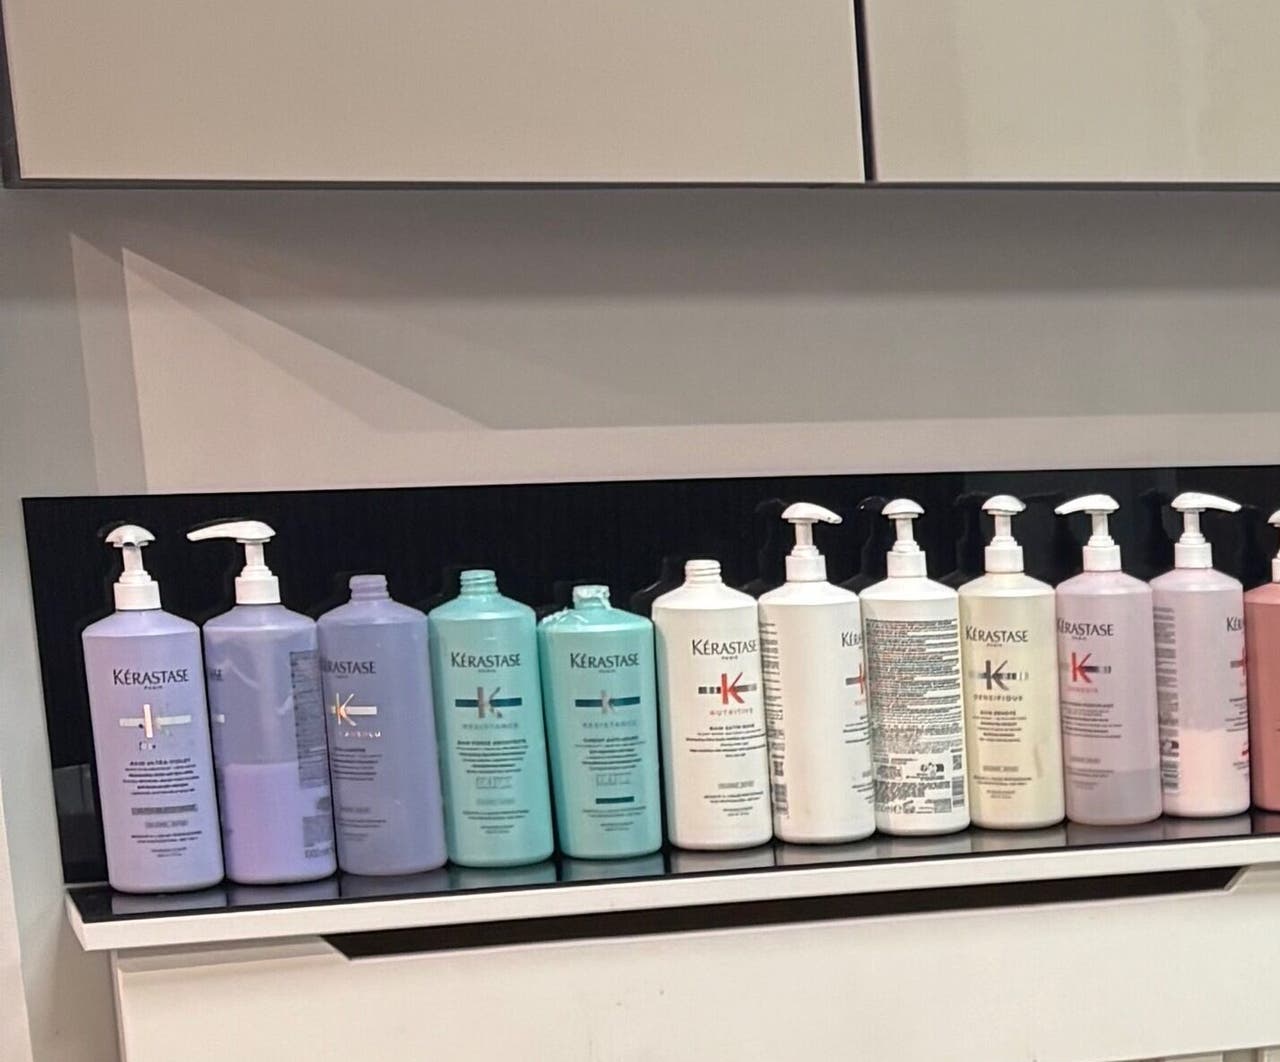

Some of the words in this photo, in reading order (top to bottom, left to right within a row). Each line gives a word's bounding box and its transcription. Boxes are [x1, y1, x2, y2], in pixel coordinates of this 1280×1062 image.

[966, 625, 1029, 643] KÉRASTASE
[692, 639, 758, 656] KÉRASTASE
[451, 652, 521, 668] KÉRASTASE
[570, 653, 640, 669] KÉRASTASE
[113, 668, 190, 686] KÉRASTASE
